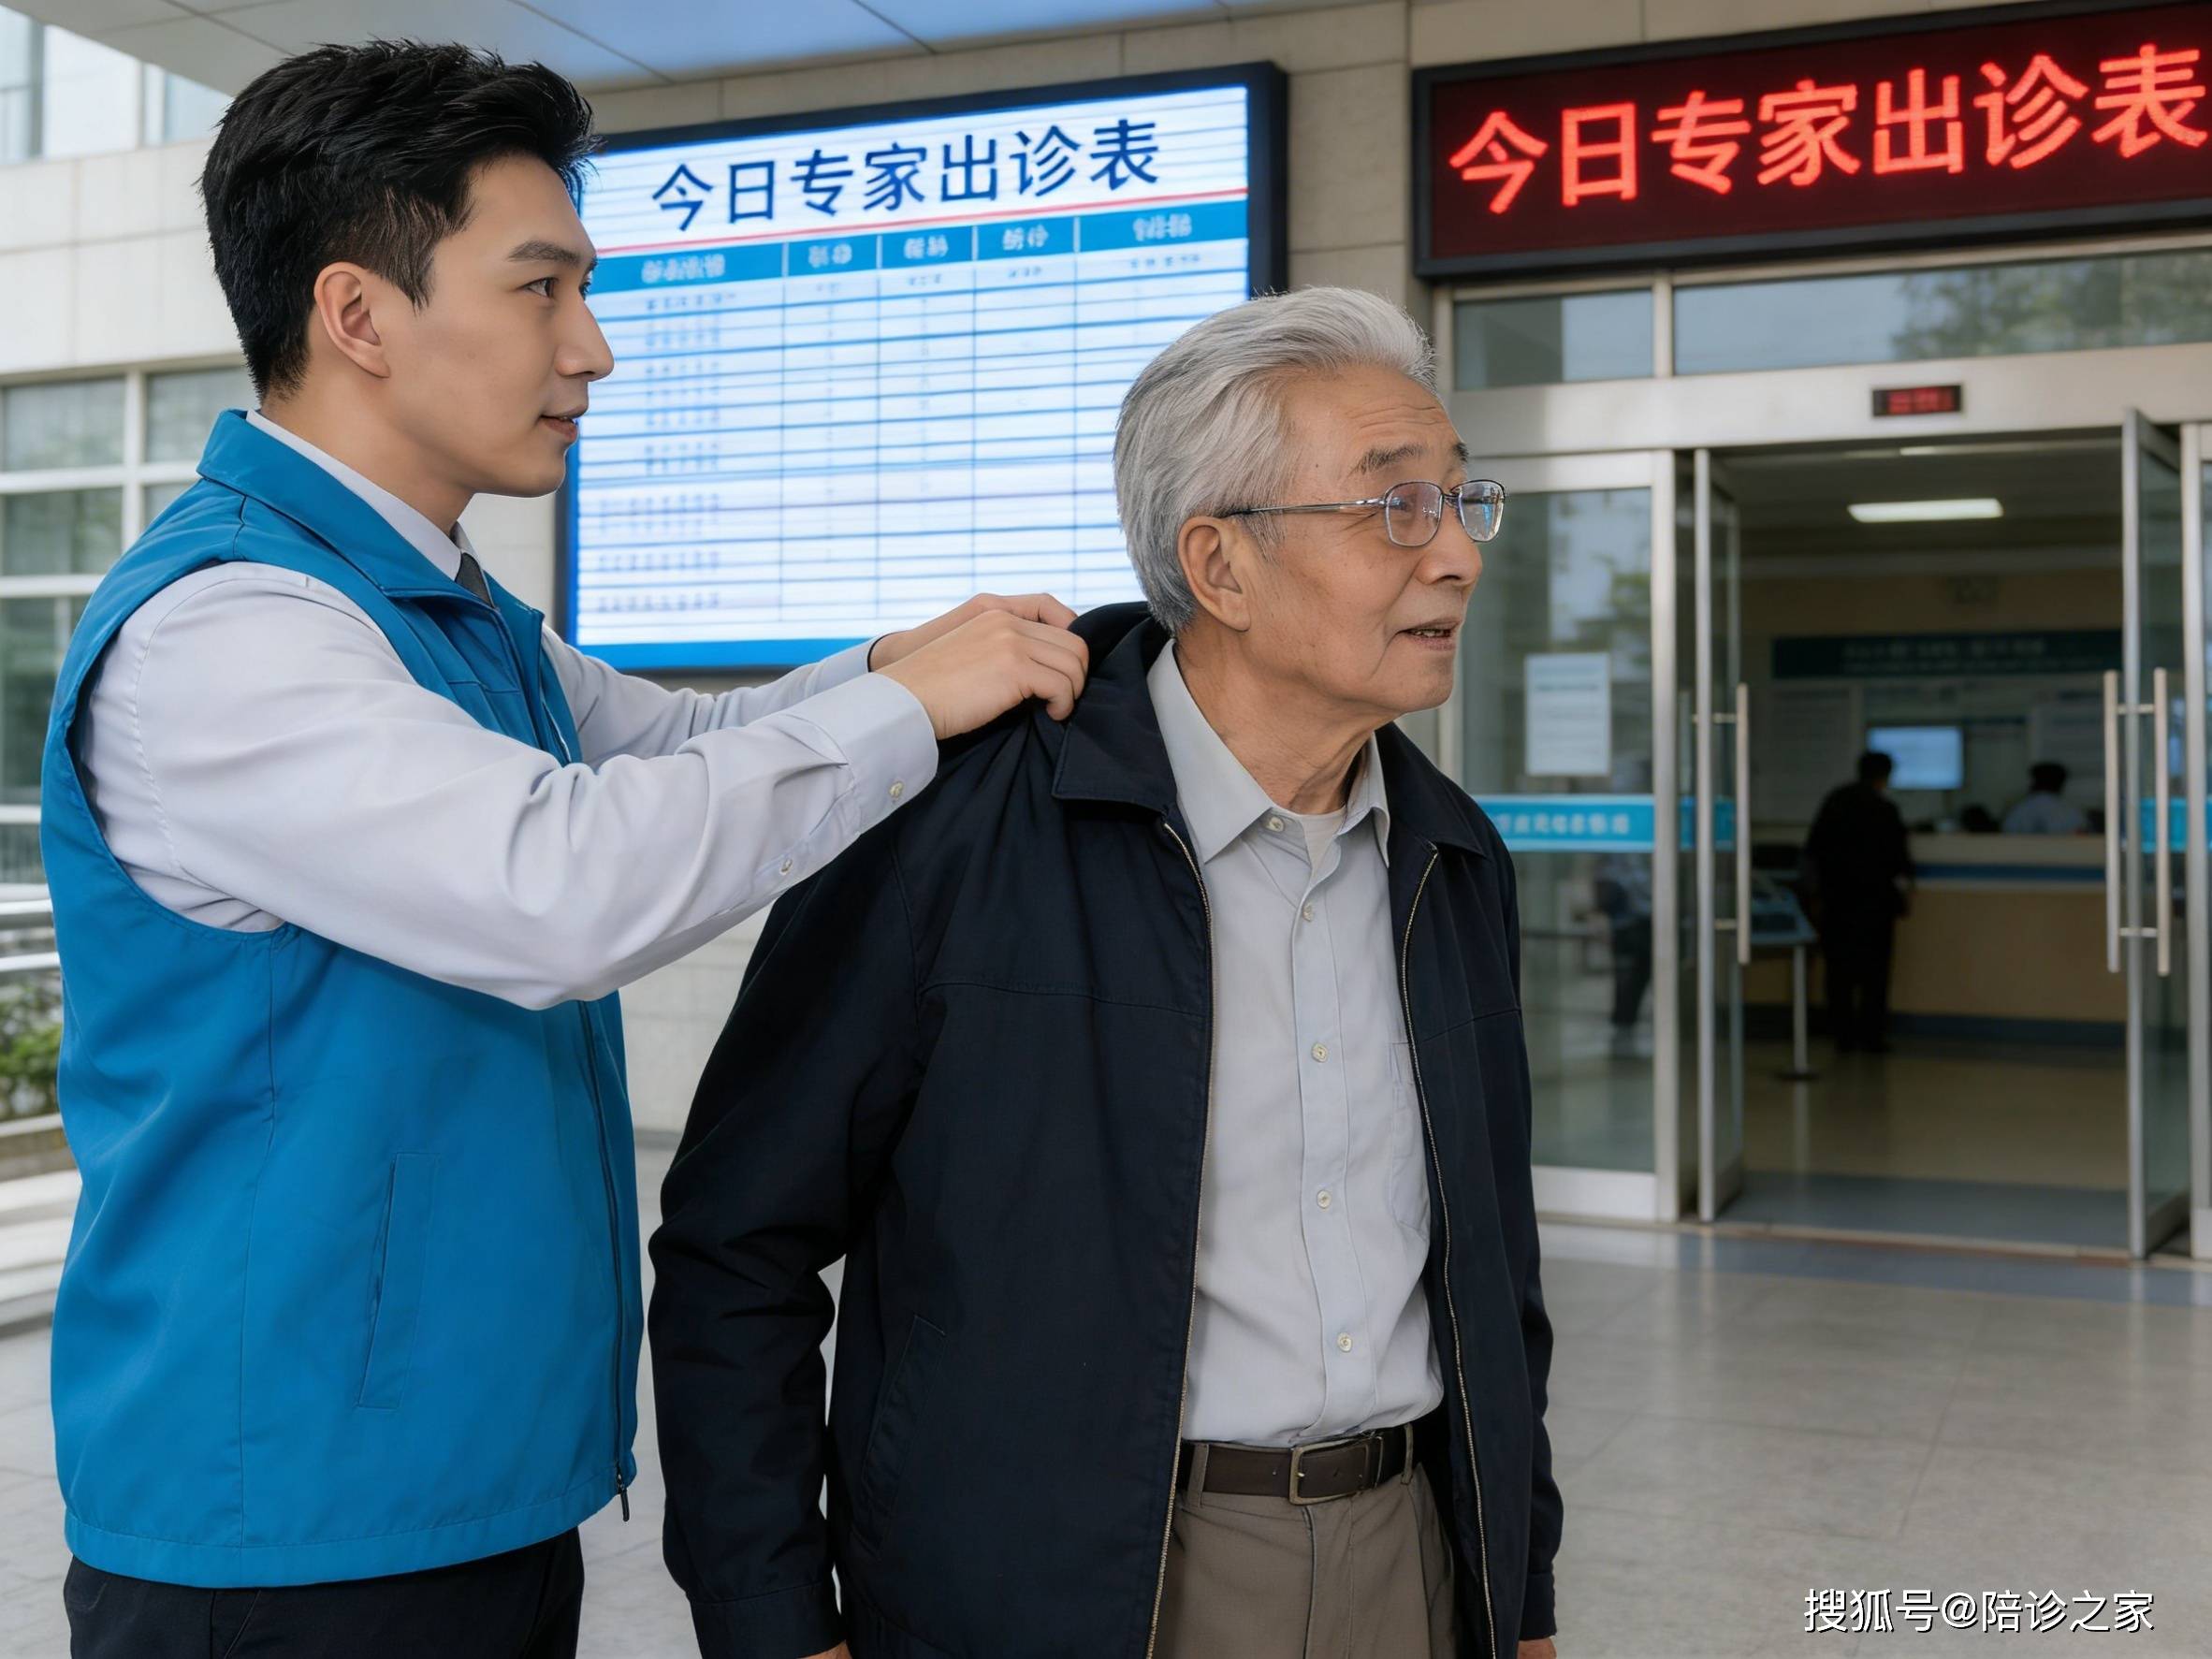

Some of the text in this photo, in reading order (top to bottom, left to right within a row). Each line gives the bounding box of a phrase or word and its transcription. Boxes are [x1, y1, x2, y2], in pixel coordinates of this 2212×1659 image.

[651, 118, 1159, 232] 今日专家出诊表
[1448, 43, 2210, 213] 今日专家出诊表
